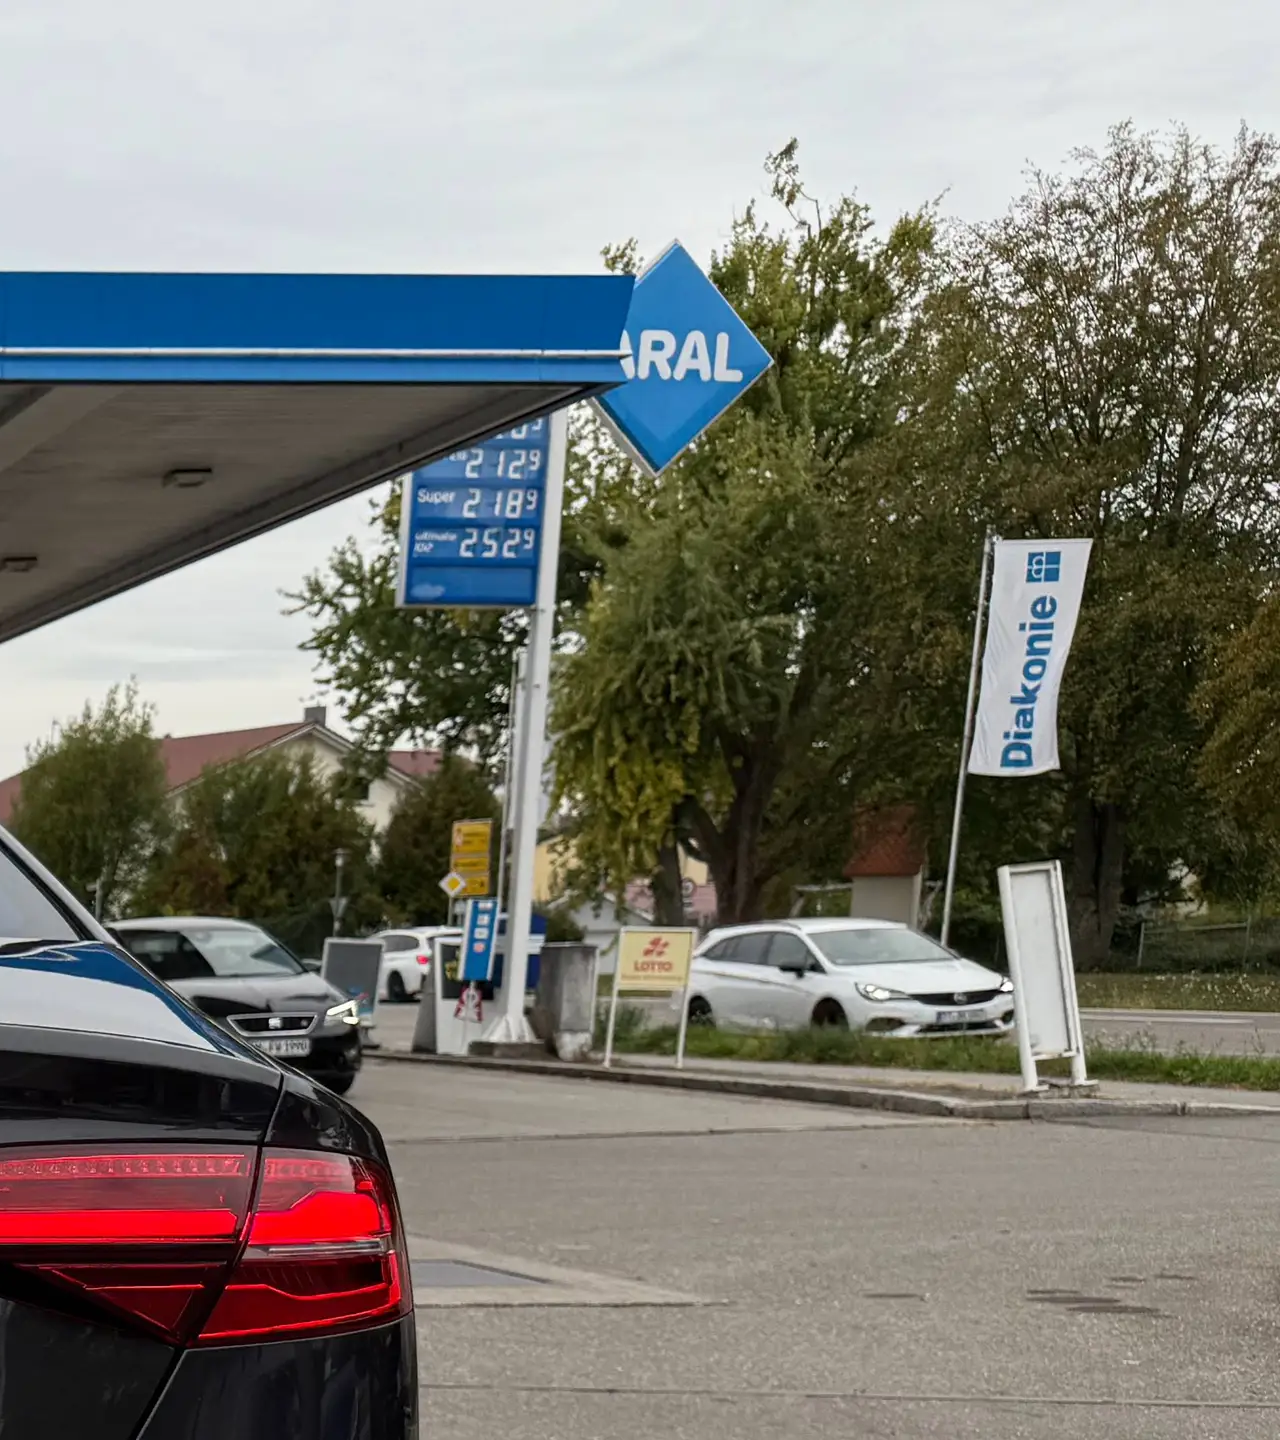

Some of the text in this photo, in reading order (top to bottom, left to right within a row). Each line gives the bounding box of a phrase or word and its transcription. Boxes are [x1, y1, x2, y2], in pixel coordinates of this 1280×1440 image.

[417, 488, 457, 506] Super
[1000, 594, 1057, 768] Diakonie
[633, 960, 673, 973] LOTTO
